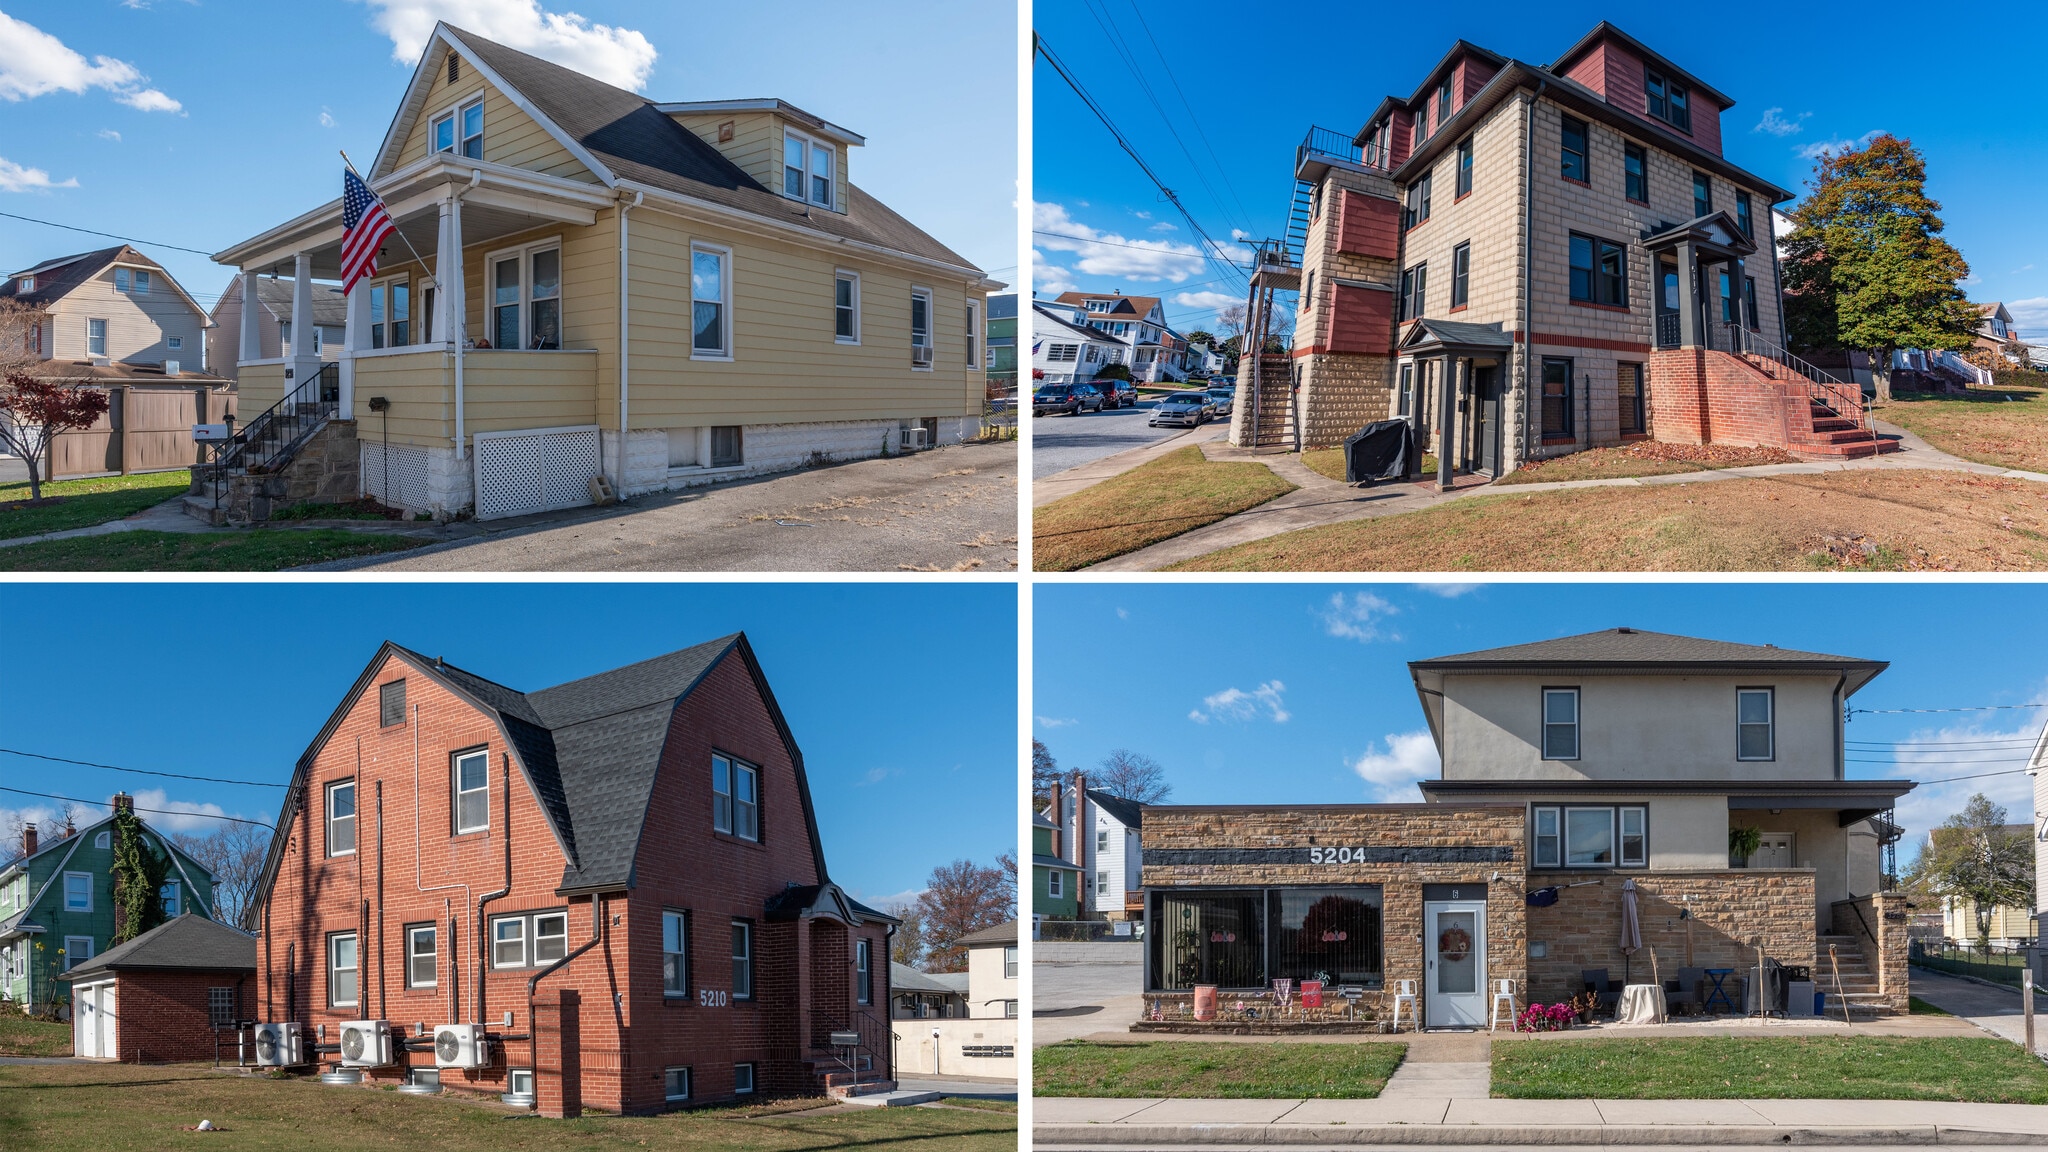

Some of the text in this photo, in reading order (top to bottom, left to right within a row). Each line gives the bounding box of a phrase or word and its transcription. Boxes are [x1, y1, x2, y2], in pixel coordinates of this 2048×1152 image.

[1310, 847, 1366, 864] 5204
[1453, 921, 1459, 929] 6
[700, 989, 727, 1007] 5210
